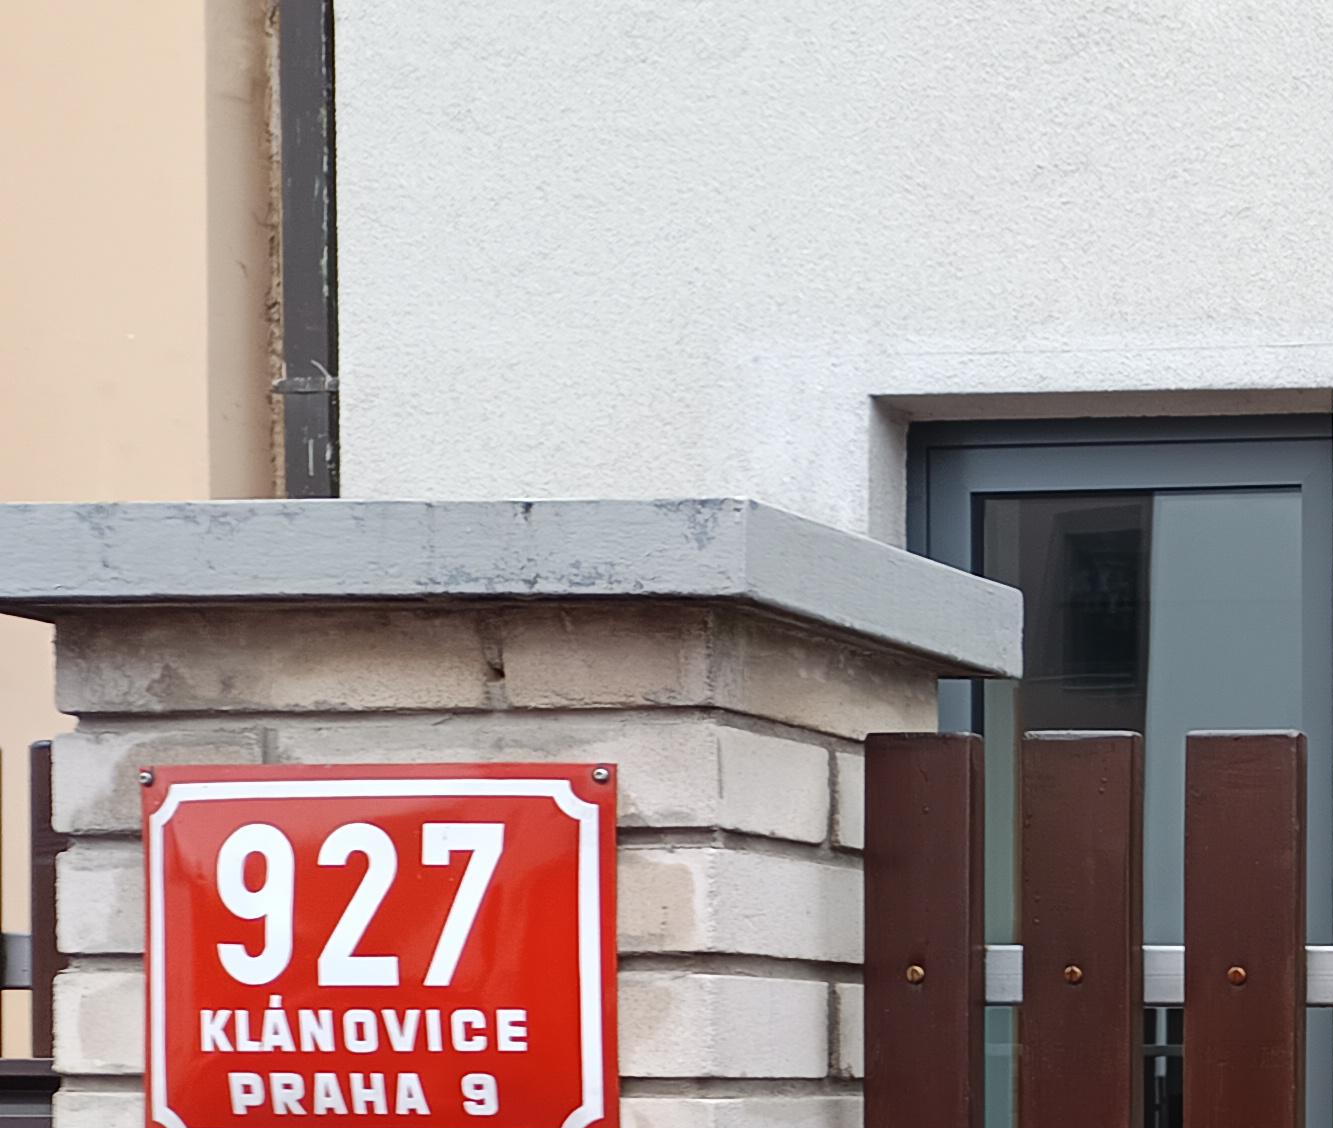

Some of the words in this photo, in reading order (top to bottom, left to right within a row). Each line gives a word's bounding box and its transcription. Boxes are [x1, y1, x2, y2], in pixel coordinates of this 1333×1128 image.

[216, 822, 505, 987] 927
[200, 994, 528, 1053] KLÁNOVICE
[228, 1072, 431, 1115] PRAHA
[461, 1074, 499, 1116] 9
